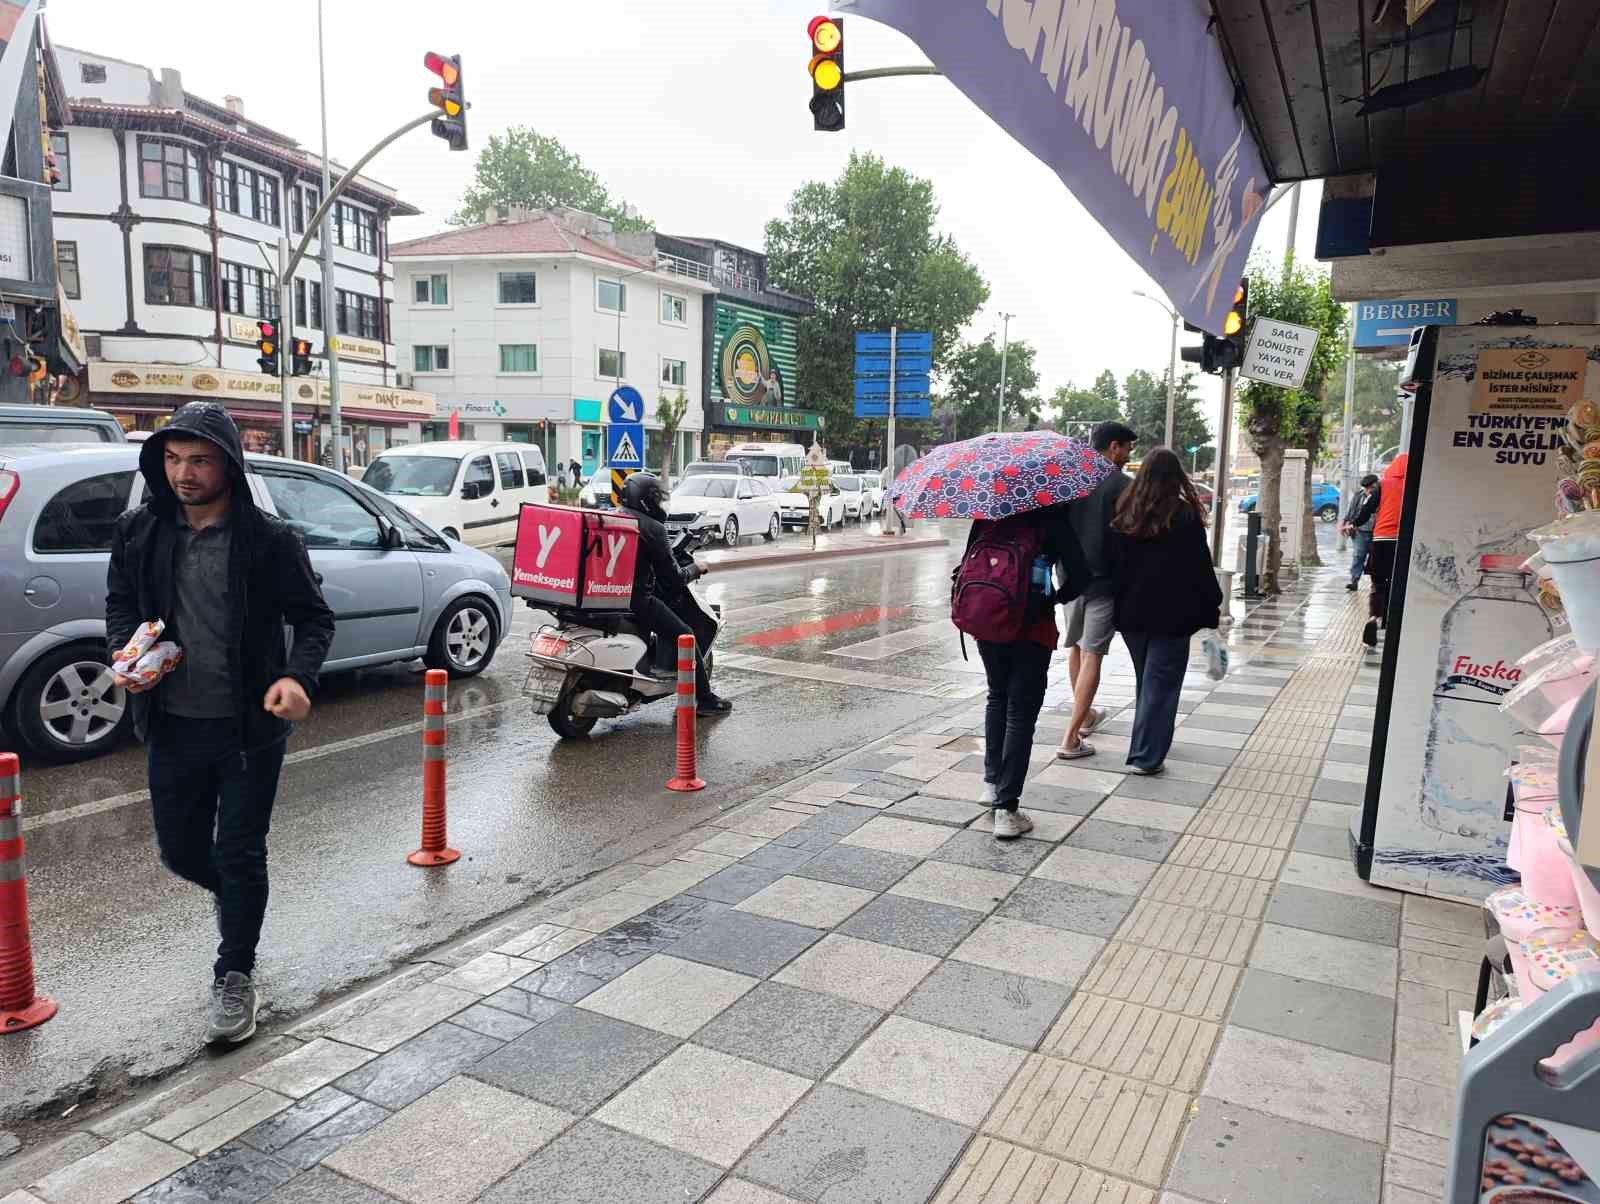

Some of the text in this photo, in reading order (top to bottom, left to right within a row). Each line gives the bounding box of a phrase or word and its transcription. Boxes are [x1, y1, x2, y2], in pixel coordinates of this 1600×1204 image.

[1362, 301, 1451, 321] BERBER
[1251, 364, 1295, 381] YOL VER
[1482, 369, 1578, 382] BİZİMLE ÇALIŞMAK
[1489, 382, 1519, 393] İSTER
[1453, 431, 1484, 448] EN
[1495, 450, 1546, 465] SUYU
[513, 567, 575, 589] Yemeksepeti
[587, 580, 633, 597] Yemeksepeti
[1453, 655, 1522, 681] Fuska
